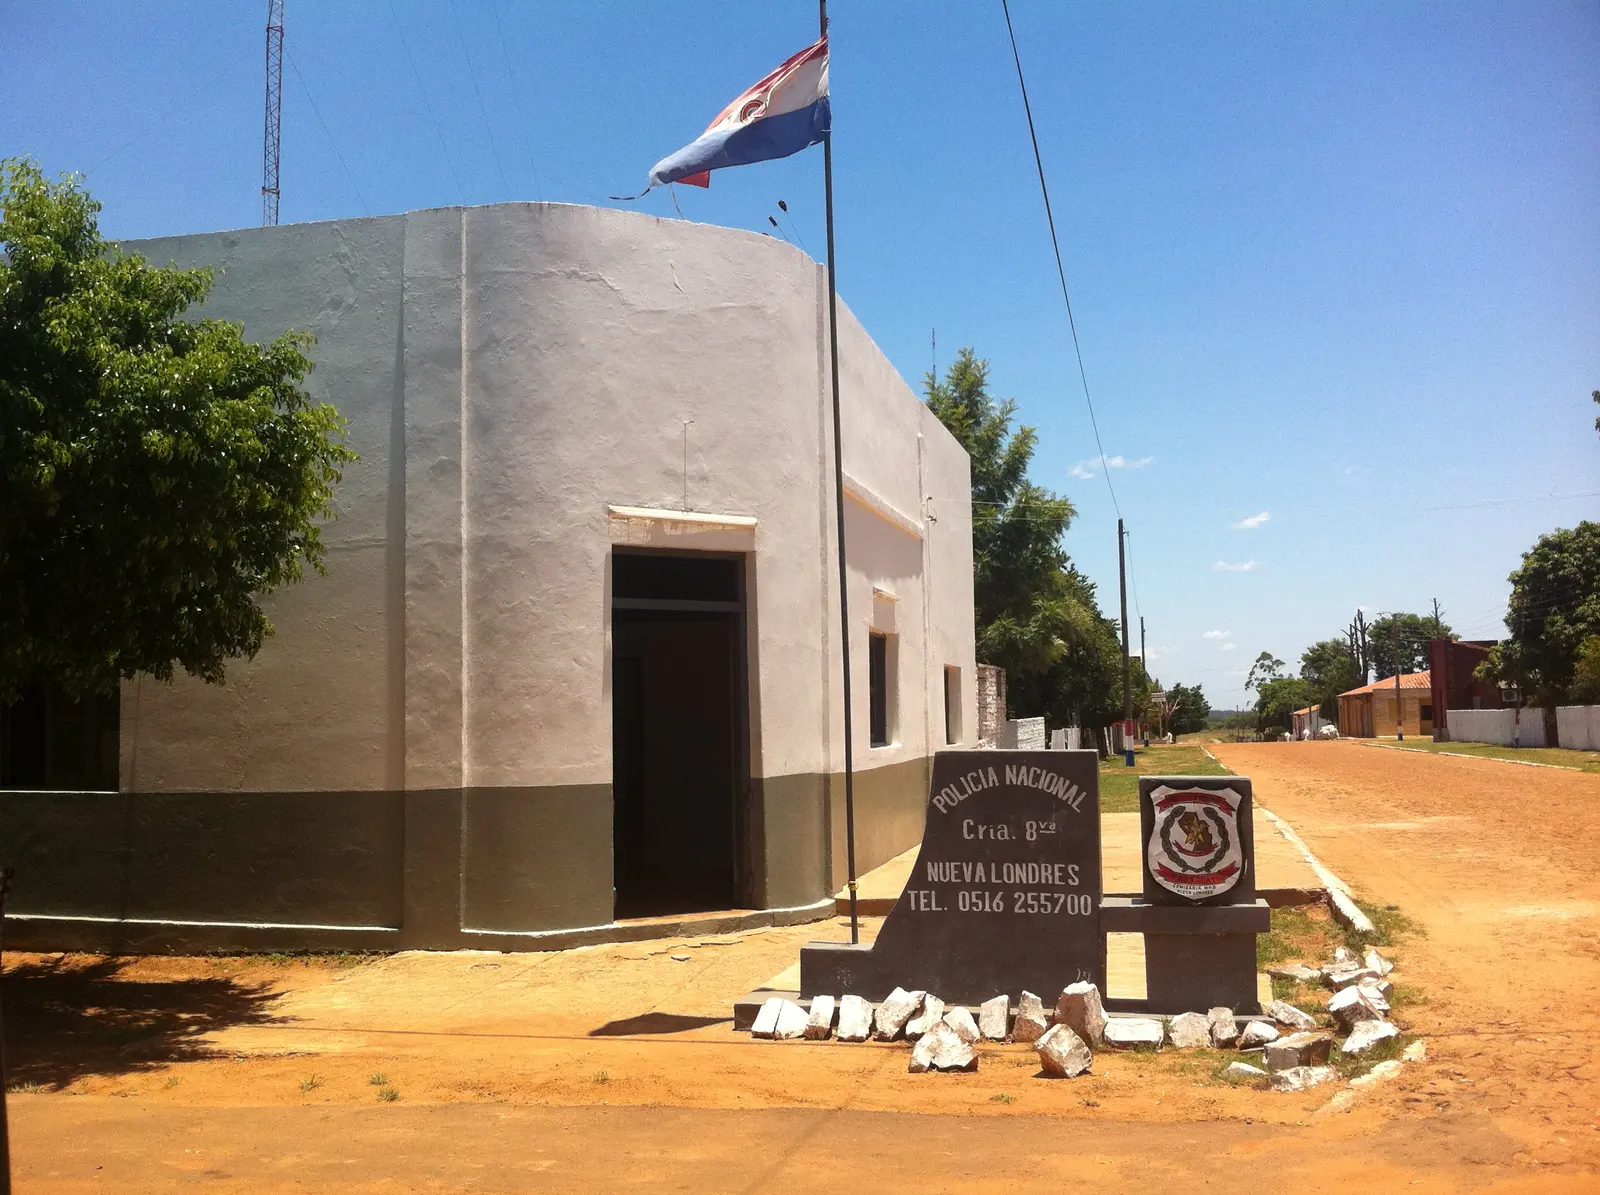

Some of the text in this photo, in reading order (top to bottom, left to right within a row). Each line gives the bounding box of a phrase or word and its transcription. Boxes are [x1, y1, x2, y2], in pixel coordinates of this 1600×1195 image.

[932, 765, 1087, 814] POLICIA NACIONAL
[962, 819, 1016, 840] Cria.
[927, 862, 1080, 886] NUEVA LONDRES
[907, 890, 1092, 915] TEL. 0516 255700
